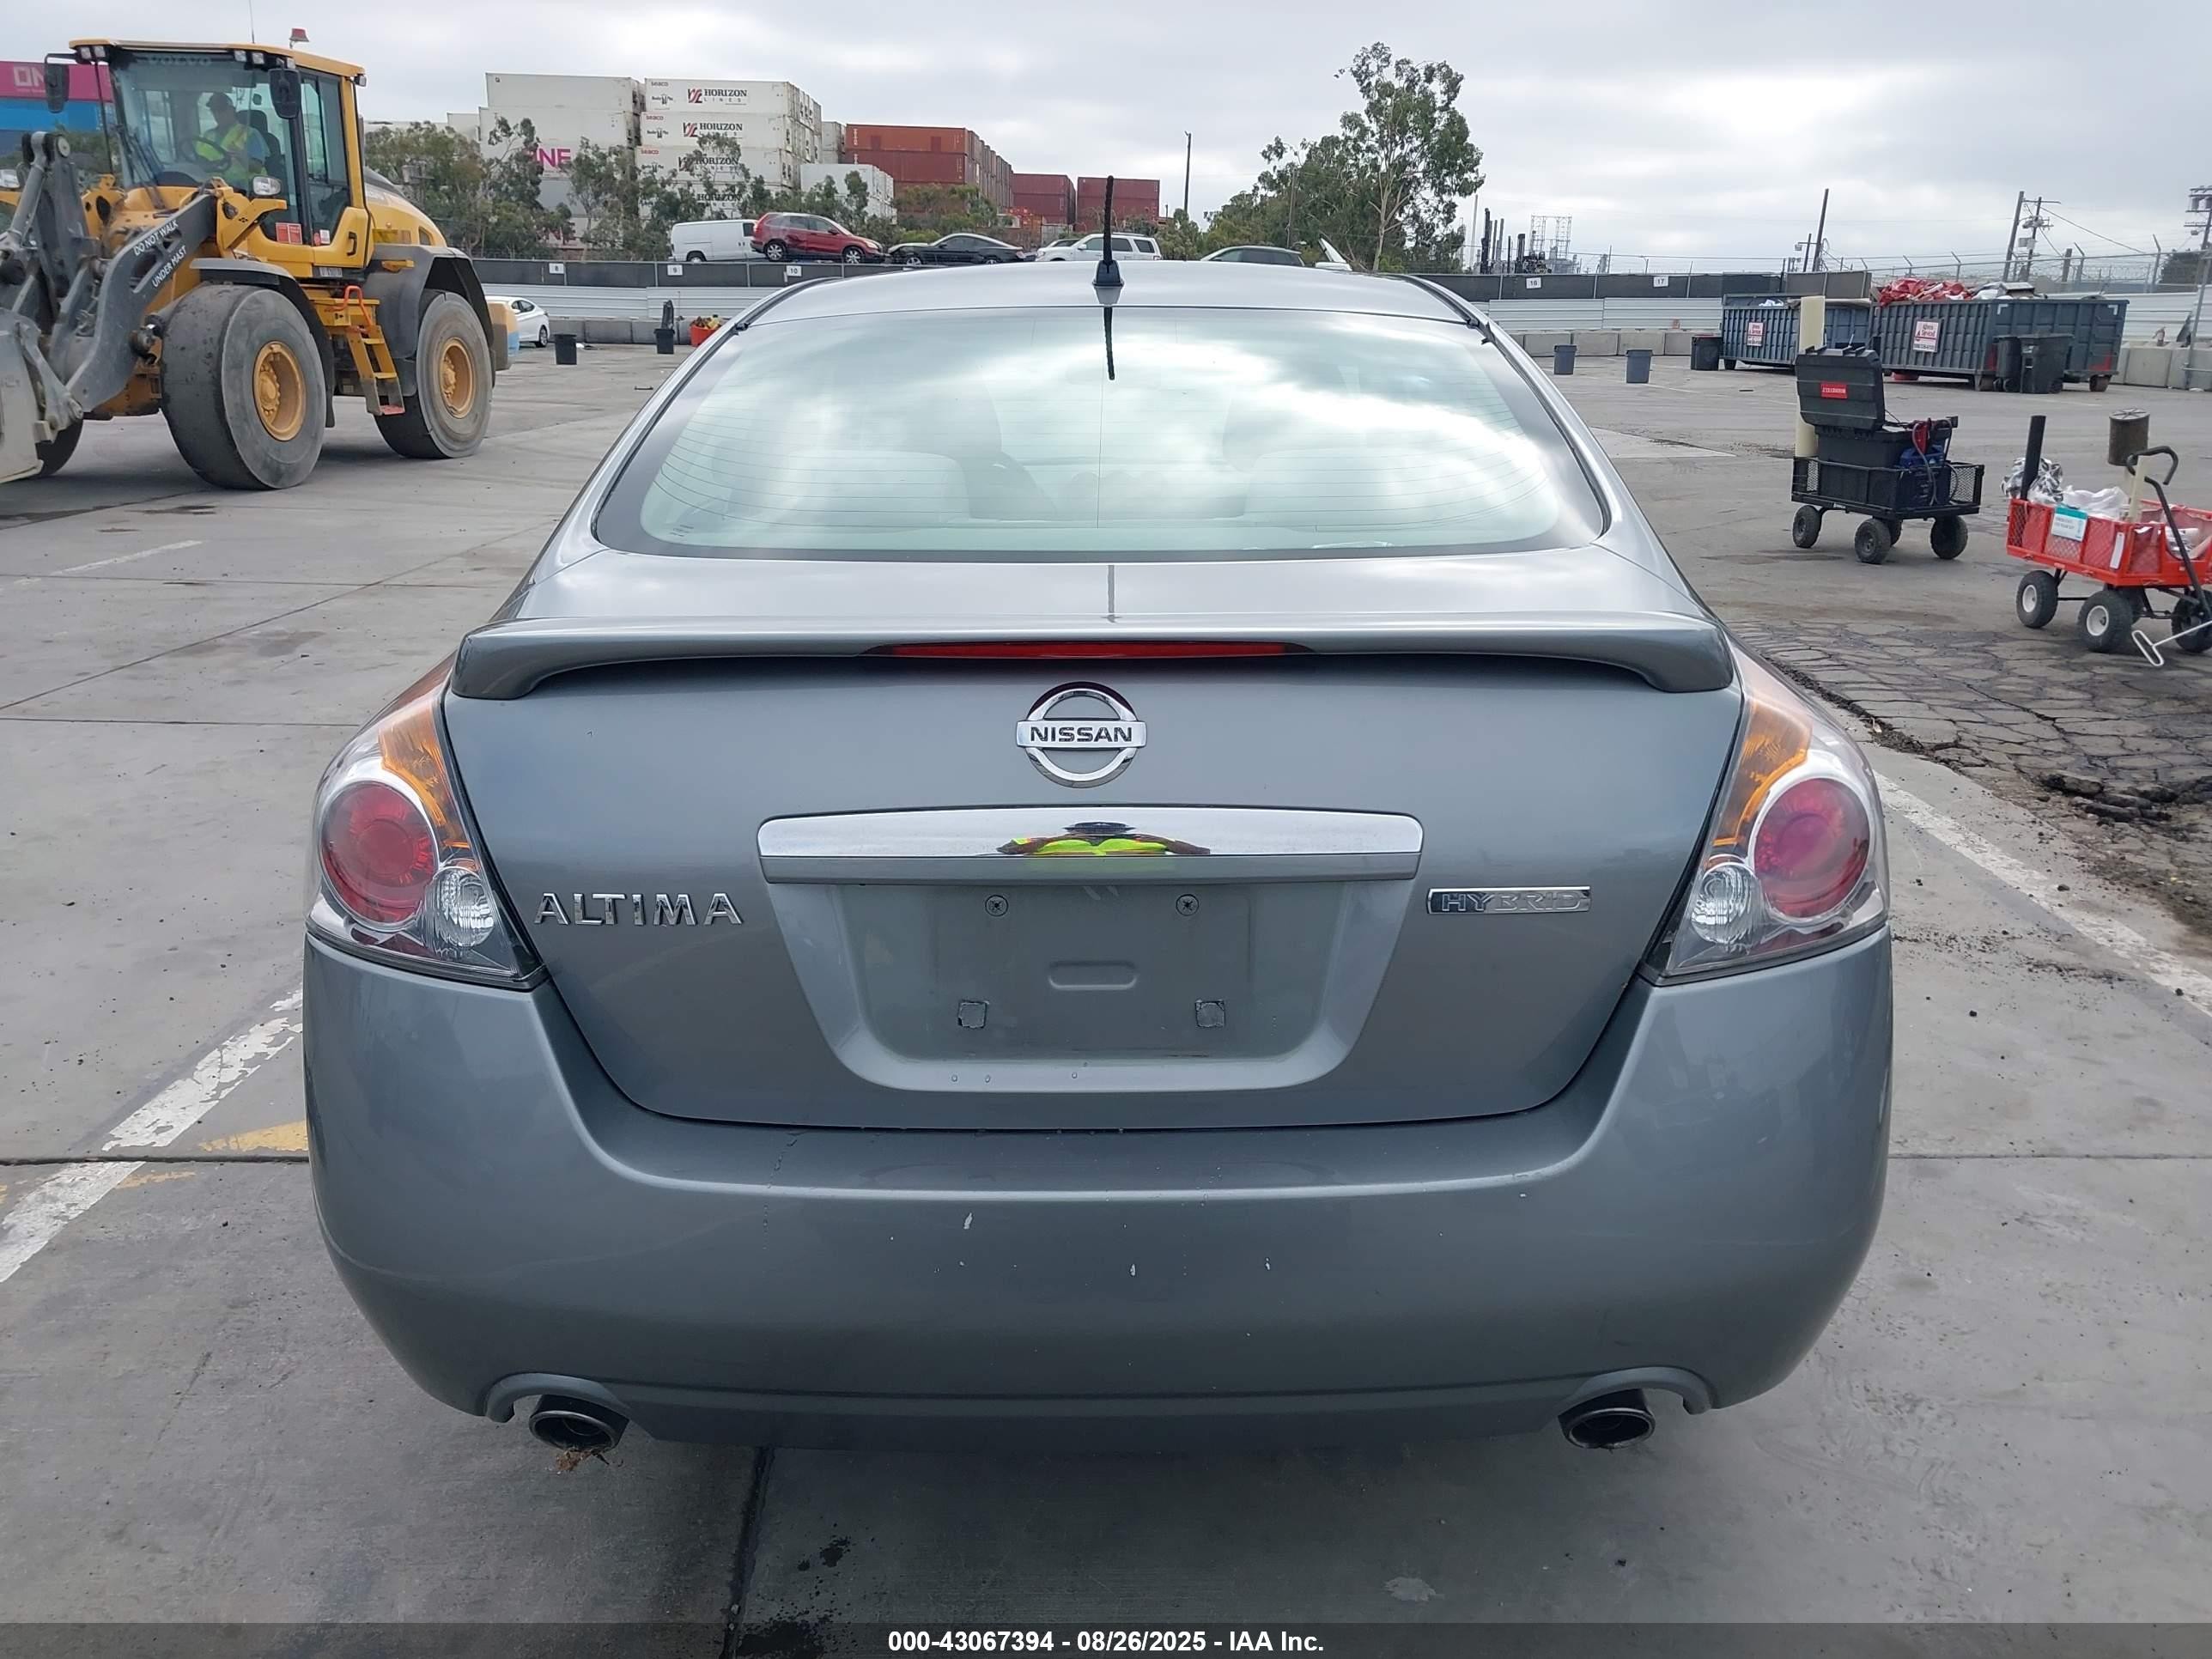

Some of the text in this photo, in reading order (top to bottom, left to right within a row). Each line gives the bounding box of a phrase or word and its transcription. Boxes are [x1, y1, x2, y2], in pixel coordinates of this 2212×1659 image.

[699, 122, 744, 131] HORIZON
[133, 220, 179, 256] DO NOT WALK
[151, 245, 187, 288] UNDER MAST
[1030, 726, 1132, 742] NISSAN
[534, 893, 744, 925] ALTIMA
[1442, 891, 1582, 912] HYBRID
